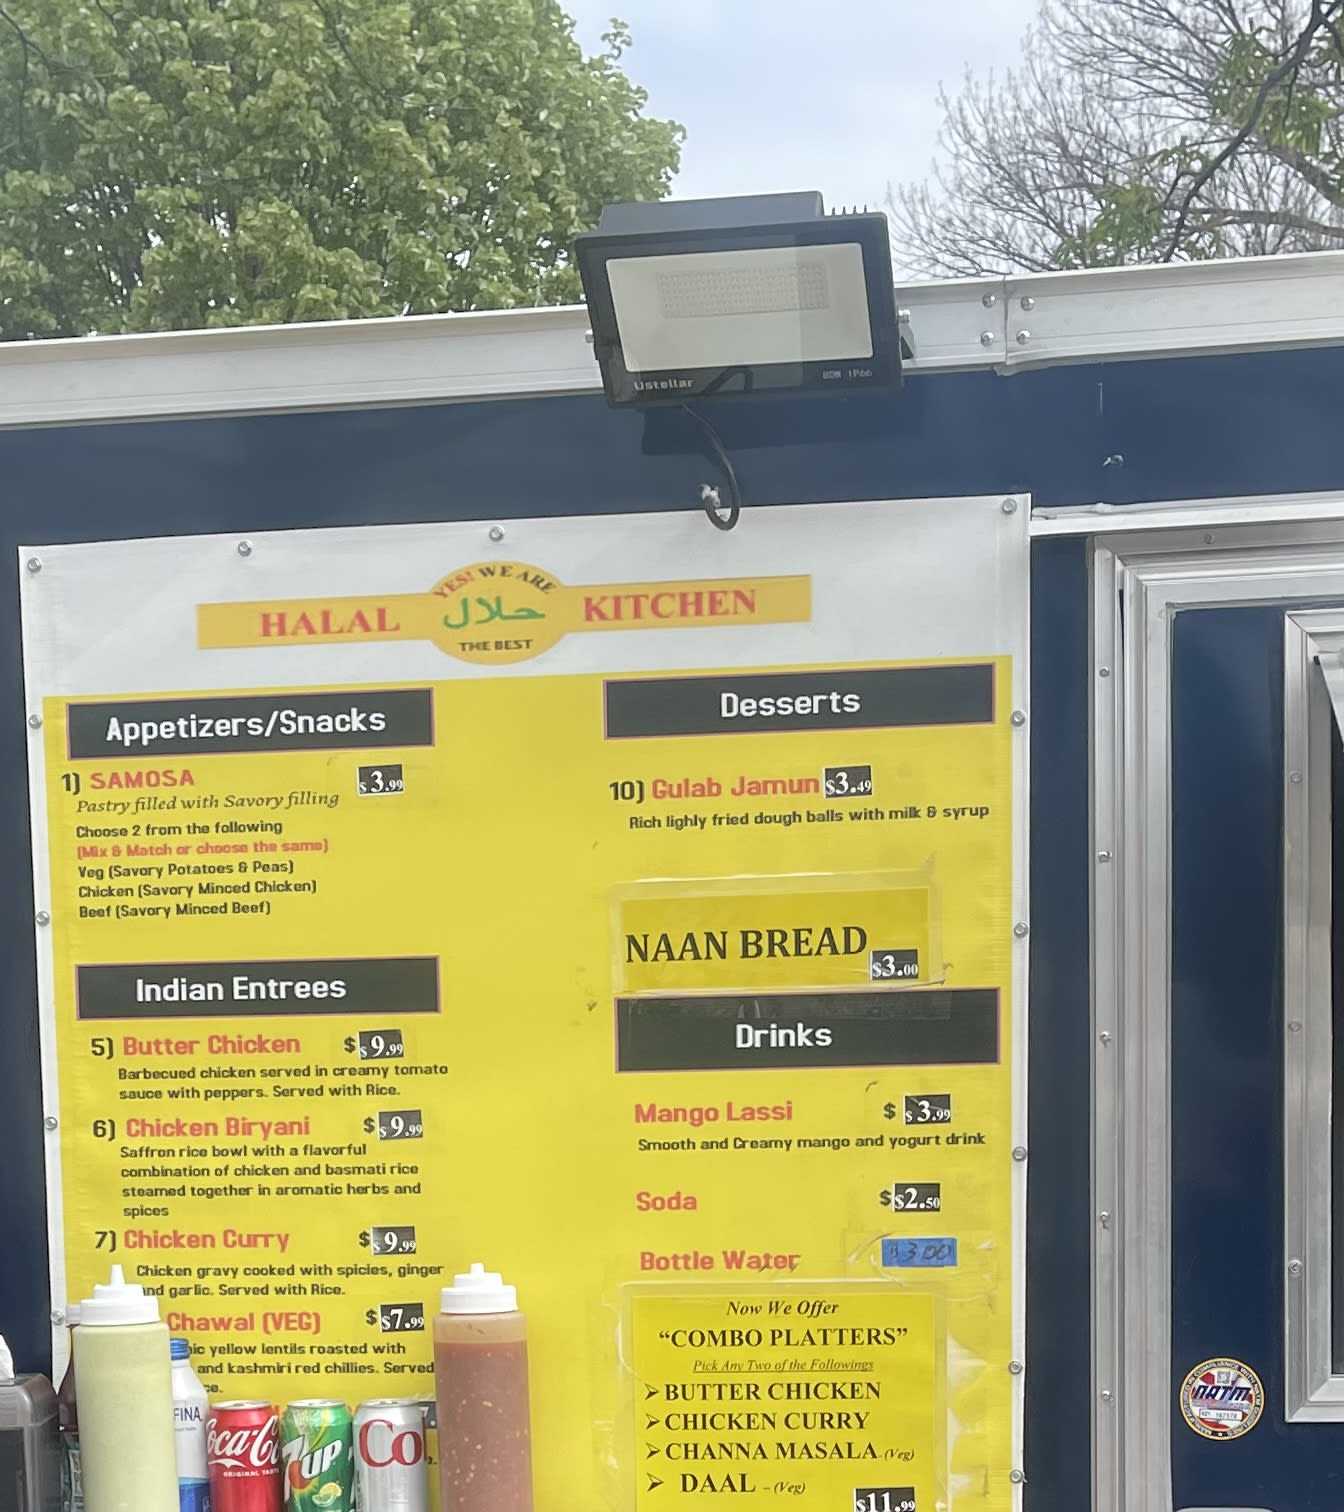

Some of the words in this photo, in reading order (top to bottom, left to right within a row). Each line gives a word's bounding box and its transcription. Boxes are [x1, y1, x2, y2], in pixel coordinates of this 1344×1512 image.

[433, 571, 475, 599] YES!
[479, 565, 514, 579] WE
[518, 570, 558, 596] ARE
[443, 595, 546, 630] حلال
[583, 589, 758, 622] KITCHEN
[259, 607, 401, 637] HALAL
[459, 640, 491, 652] THE
[495, 639, 534, 650] BEST
[720, 692, 861, 717] Desserts
[105, 708, 386, 745] Appetizers/Snacks
[61, 773, 80, 794] 1)
[90, 770, 195, 789] SAMOSA
[609, 780, 644, 804] 10)
[651, 778, 722, 800] Gulab
[731, 776, 820, 797] Jamun
[77, 799, 131, 814] Pastry
[133, 798, 177, 815] filled
[181, 796, 219, 809] with
[224, 794, 284, 810] Savory
[286, 792, 340, 809] filling
[629, 816, 661, 830] Rich
[666, 813, 707, 830] lighly
[712, 812, 749, 826] fried
[754, 809, 802, 827] dough
[806, 808, 844, 823] balls
[849, 807, 885, 821] with
[888, 806, 921, 819] milk
[927, 806, 937, 818] &
[943, 805, 990, 819] syrup
[79, 866, 104, 880] Veg
[109, 865, 163, 879] (Savory
[168, 862, 233, 875] Potatoes
[238, 862, 248, 873] &
[253, 861, 294, 874] Peas)
[625, 930, 729, 963] NAAN
[739, 926, 868, 960] BREAD
[136, 978, 224, 1002] Indian
[233, 977, 347, 1000] Entrees
[91, 1038, 114, 1059] 5)
[123, 1036, 200, 1055] Butter
[208, 1034, 301, 1054] Chicken
[344, 1035, 356, 1054] $
[736, 1023, 832, 1049] Drinks
[635, 1103, 719, 1127] Mango
[727, 1101, 793, 1122] Lassi
[883, 1102, 896, 1120] $
[93, 1119, 115, 1140] 6)
[127, 1119, 218, 1138] Chicken
[226, 1116, 310, 1141] Biryani
[363, 1117, 375, 1135] $
[636, 1191, 698, 1212] Soda
[879, 1190, 891, 1207] $
[95, 1231, 116, 1253] 7)
[124, 1230, 216, 1249] Chicken
[223, 1230, 289, 1253] Curry
[358, 1230, 370, 1248] $
[137, 1264, 192, 1277] Chicken
[197, 1266, 238, 1279] gravy
[243, 1264, 294, 1276] cooked
[299, 1264, 330, 1276] with
[398, 1264, 444, 1277] ginger
[640, 1250, 714, 1271] Bottle
[722, 1250, 801, 1271] Water
[726, 1301, 762, 1316] Now
[767, 1301, 793, 1316] We
[797, 1300, 839, 1318] Offer
[168, 1312, 254, 1331] Chawal
[263, 1311, 320, 1334] (VEG)
[366, 1310, 377, 1325] $
[664, 1383, 761, 1402] BUTTER
[767, 1382, 881, 1400] CHICKEN
[665, 1413, 777, 1431] CHICKEN
[784, 1411, 870, 1430] CURRY
[665, 1442, 768, 1461] CHANNA
[776, 1441, 878, 1460] MASALA
[680, 1474, 756, 1493] DAAL
